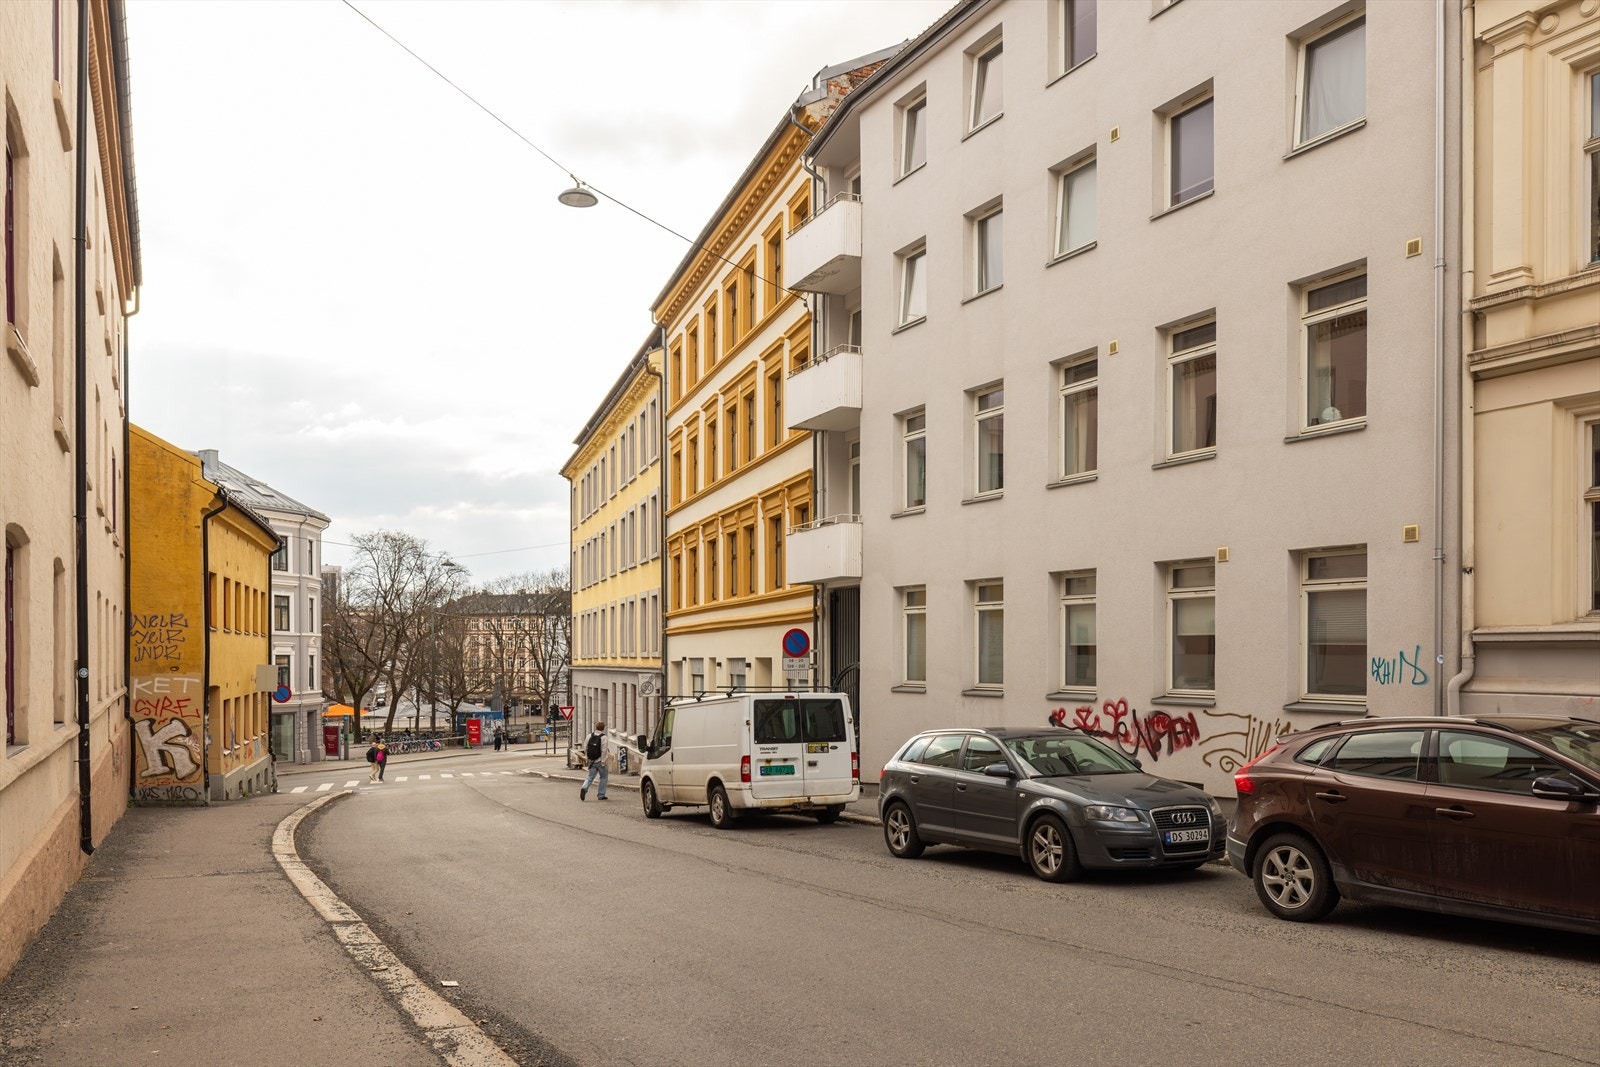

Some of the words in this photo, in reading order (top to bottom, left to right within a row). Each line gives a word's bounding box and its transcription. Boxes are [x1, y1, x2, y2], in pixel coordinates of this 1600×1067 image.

[133, 677, 199, 699] KET
[1172, 832, 1183, 842] DS
[1185, 830, 1208, 841] 30294
